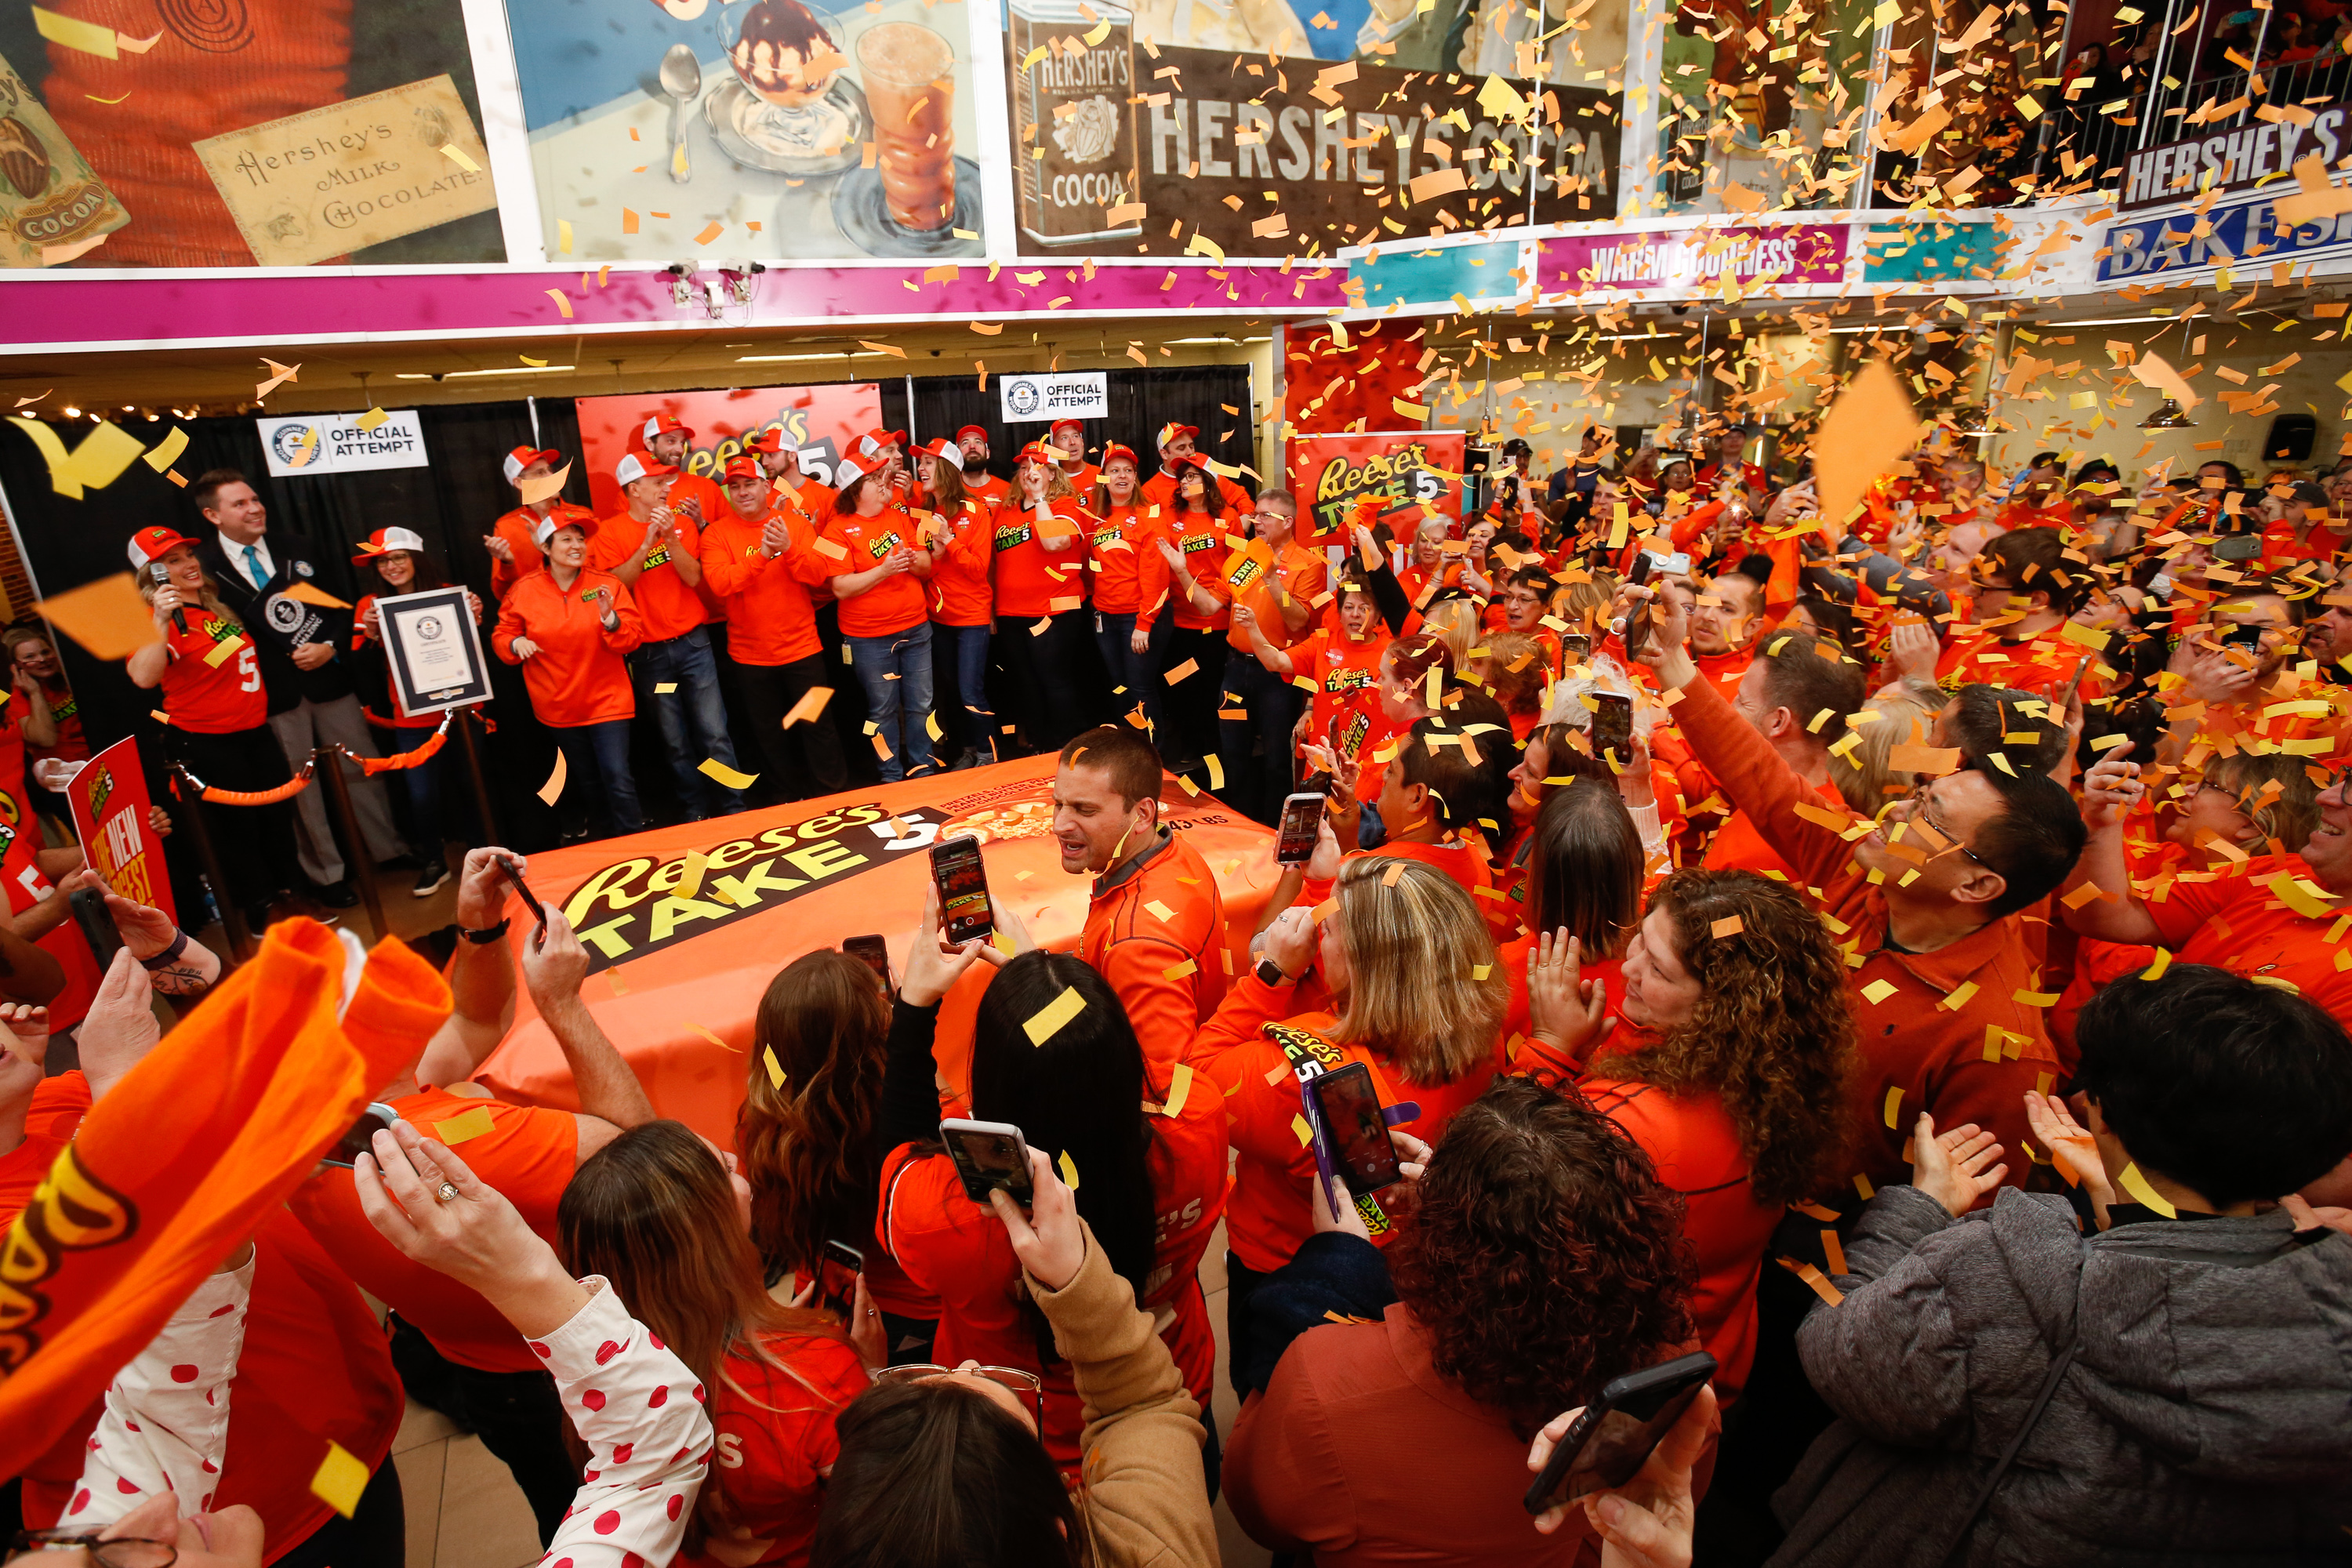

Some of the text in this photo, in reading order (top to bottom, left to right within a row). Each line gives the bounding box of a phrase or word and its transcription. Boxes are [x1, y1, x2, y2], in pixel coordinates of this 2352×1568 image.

[235, 124, 392, 187] Hershey's
[317, 161, 400, 191] MILK
[1052, 172, 1124, 208] COCOA
[24, 192, 103, 238] COCOA
[2107, 202, 2282, 277] BAKE
[1591, 238, 1798, 283] WARM GOODNESS
[1047, 384, 1101, 396] OFFICIAL
[1047, 396, 1101, 408] ATTEMPT
[332, 426, 412, 441] OFFICIAL
[336, 441, 413, 456] ATTEMPT
[797, 446, 833, 487] 5
[1318, 444, 1426, 502] Reese's
[1415, 470, 1439, 499] 5
[869, 529, 893, 551] Reese's
[891, 534, 900, 544] 5
[996, 521, 1031, 540] Reese's
[996, 529, 1029, 550] TAKE 5
[1093, 530, 1121, 546] TAKE 5
[1207, 538, 1214, 548] 5
[644, 554, 666, 570] AKE
[1229, 560, 1256, 586] TAKE 5
[239, 646, 261, 693] 5
[1328, 667, 1369, 681] Rese's
[1363, 677, 1371, 688] 5
[1360, 714, 1370, 730] 5
[105, 773, 114, 792] 5
[954, 804, 976, 813] AND
[1192, 815, 1229, 825] LBS
[106, 804, 143, 873] NEW
[564, 803, 885, 930] Reese's
[576, 812, 940, 960] TAKE 5
[1294, 1060, 1324, 1083] 5
[1359, 1195, 1390, 1229] TAKE
